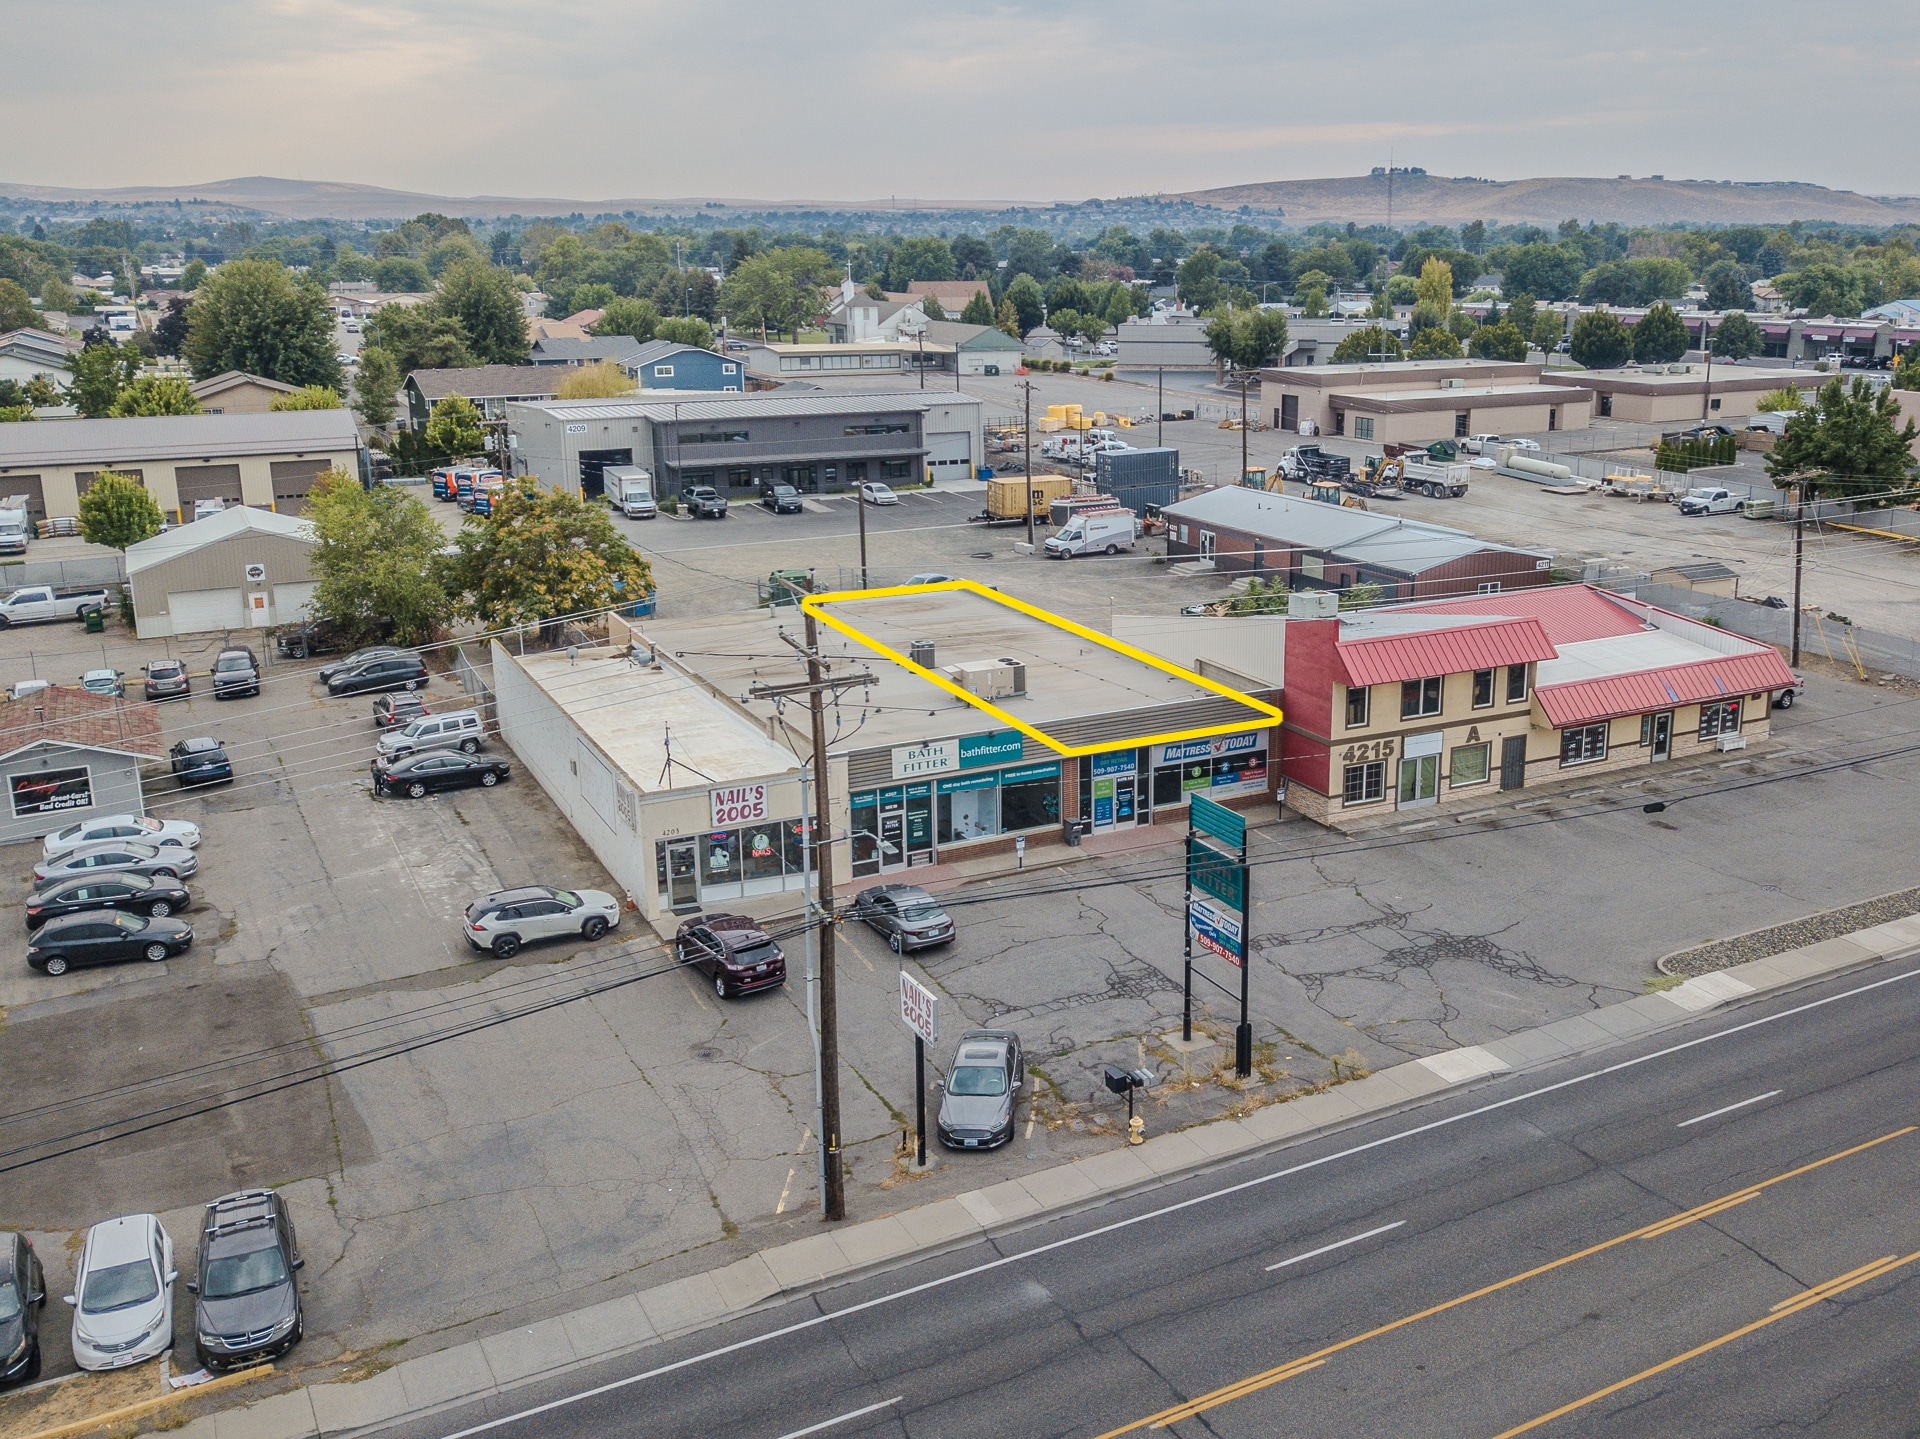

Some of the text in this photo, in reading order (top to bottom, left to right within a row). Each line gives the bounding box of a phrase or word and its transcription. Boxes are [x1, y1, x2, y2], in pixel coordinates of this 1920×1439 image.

[1466, 725, 1480, 743] A
[908, 742, 1021, 760] BATH bathfitter.com
[1166, 744, 1211, 760] MATTRESS
[1226, 734, 1255, 749] TODAY
[1343, 739, 1394, 762] 4215
[904, 759, 948, 772] FITTER
[1094, 763, 1134, 775] 509-907-7540
[40, 798, 88, 812] Bad Credit OK!
[50, 791, 88, 802] Great Cars!
[716, 786, 764, 807] NAIL'S
[716, 802, 764, 824] 2005
[752, 848, 771, 857] NAILS
[1222, 919, 1238, 934] TODAY
[1200, 934, 1240, 966] 509-907-7540
[902, 978, 931, 1019] NAIL'S
[903, 1000, 931, 1037] 2005
